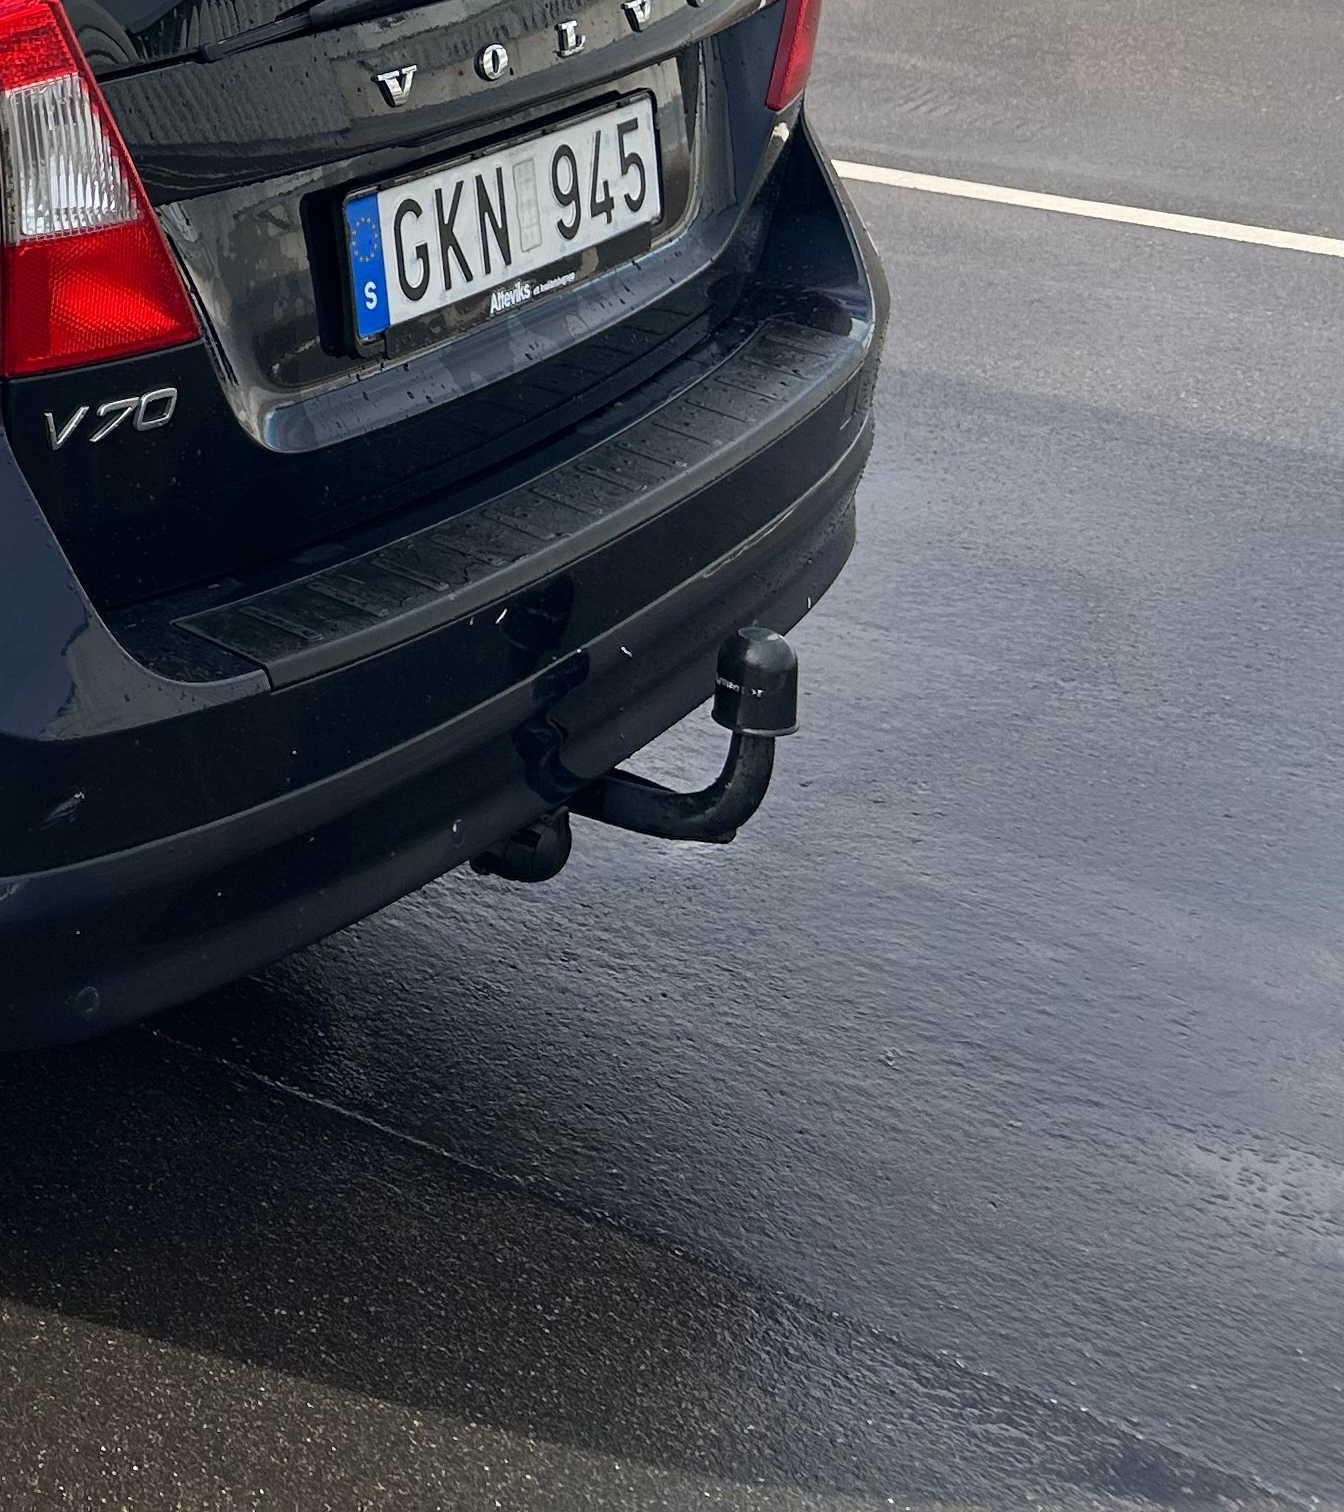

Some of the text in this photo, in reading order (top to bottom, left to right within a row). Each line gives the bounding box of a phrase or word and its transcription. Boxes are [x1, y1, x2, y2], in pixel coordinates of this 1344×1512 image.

[393, 166, 512, 301] GKN
[551, 118, 646, 240] 945
[363, 281, 377, 310] S
[43, 387, 178, 451] V70
